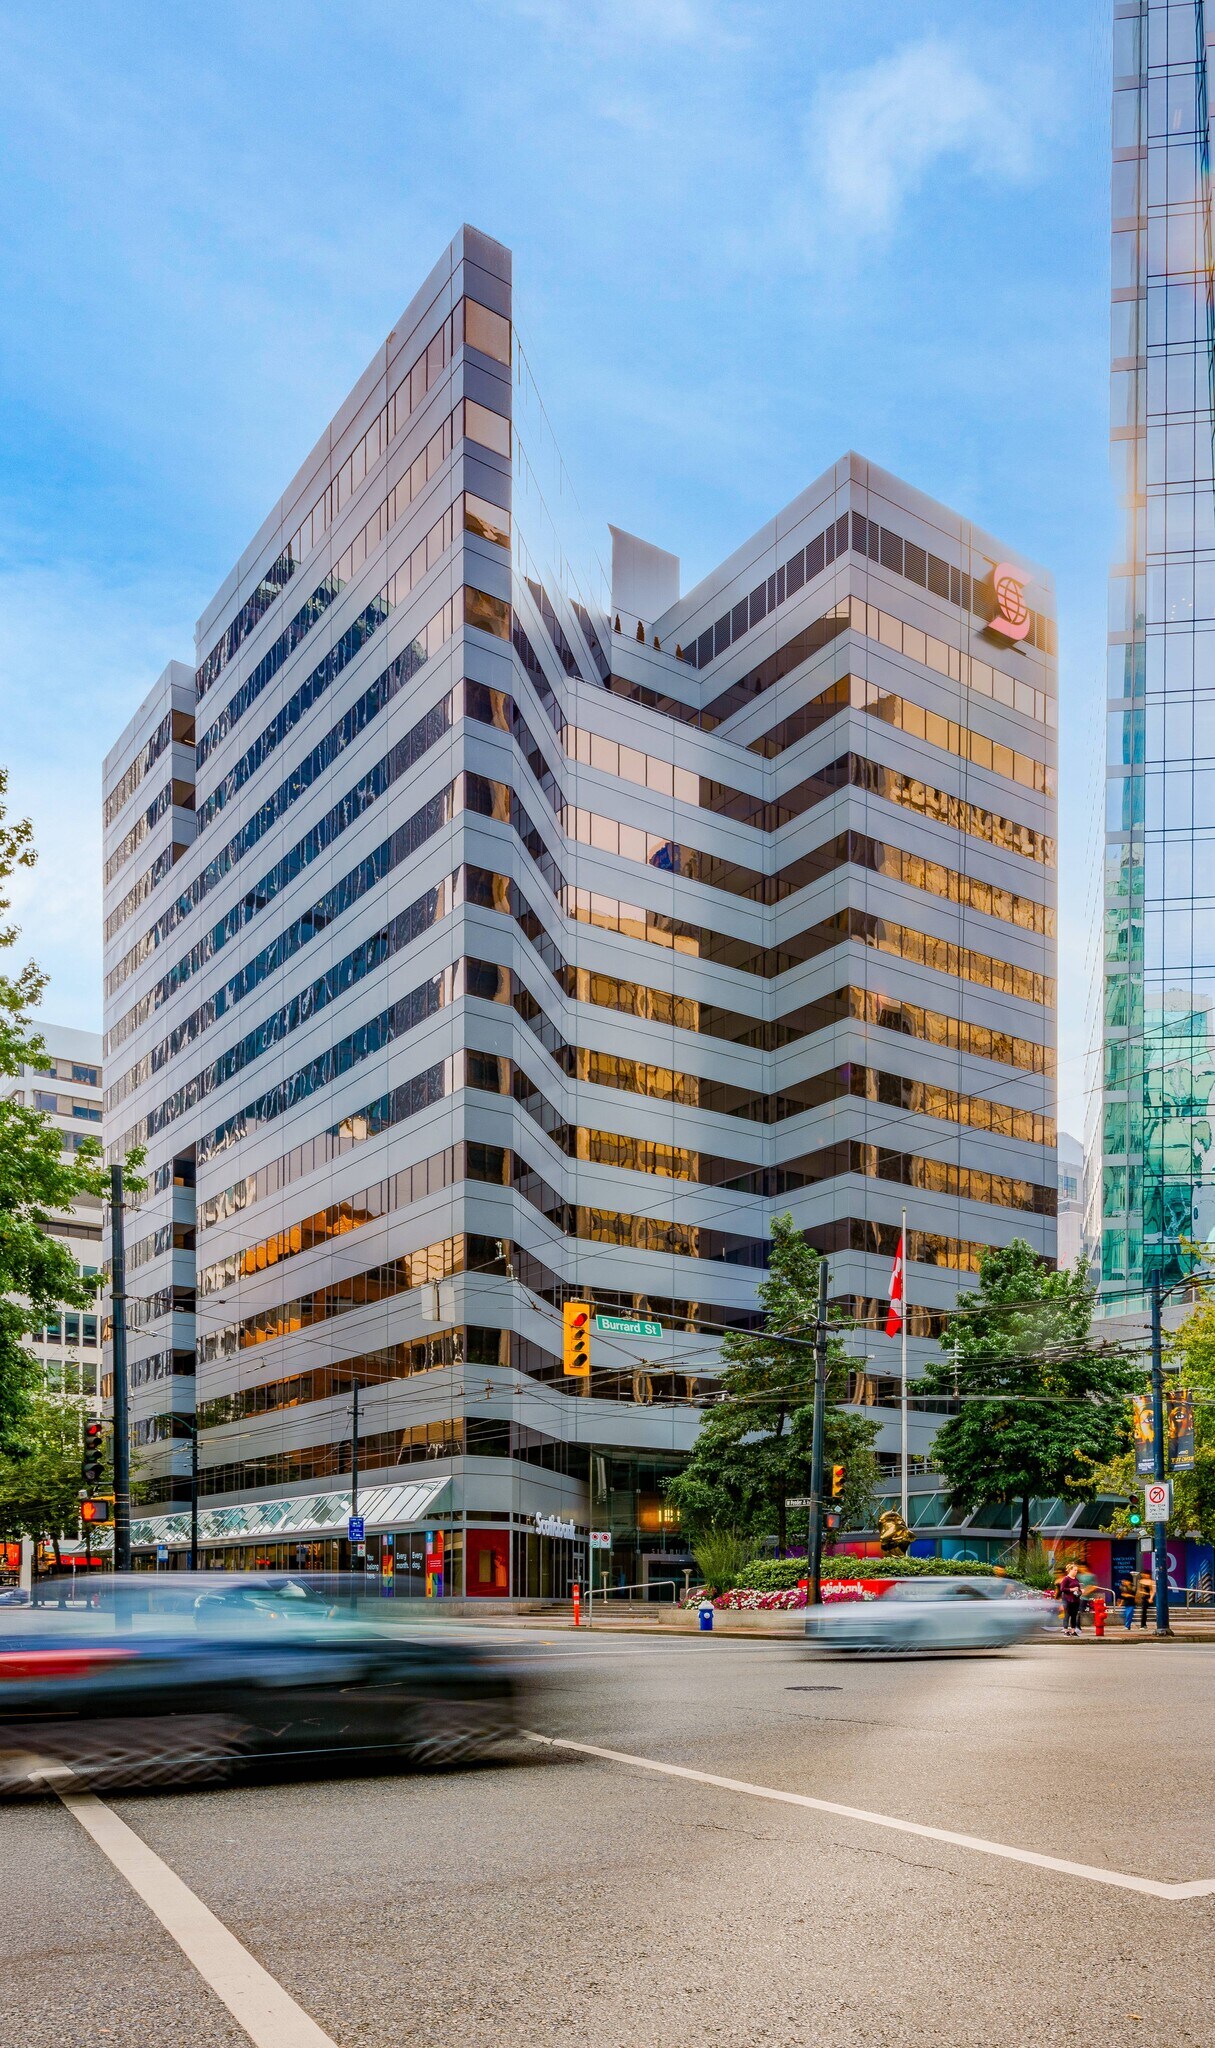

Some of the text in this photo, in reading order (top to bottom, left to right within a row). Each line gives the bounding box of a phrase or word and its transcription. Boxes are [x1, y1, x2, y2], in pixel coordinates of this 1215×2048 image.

[602, 1319, 657, 1335] Burrard St
[536, 1511, 576, 1540] Scotiabank
[396, 1552, 407, 1561] Every
[412, 1551, 423, 1560] Every
[366, 1563, 379, 1571] belong
[820, 1581, 863, 1595] otiabank
